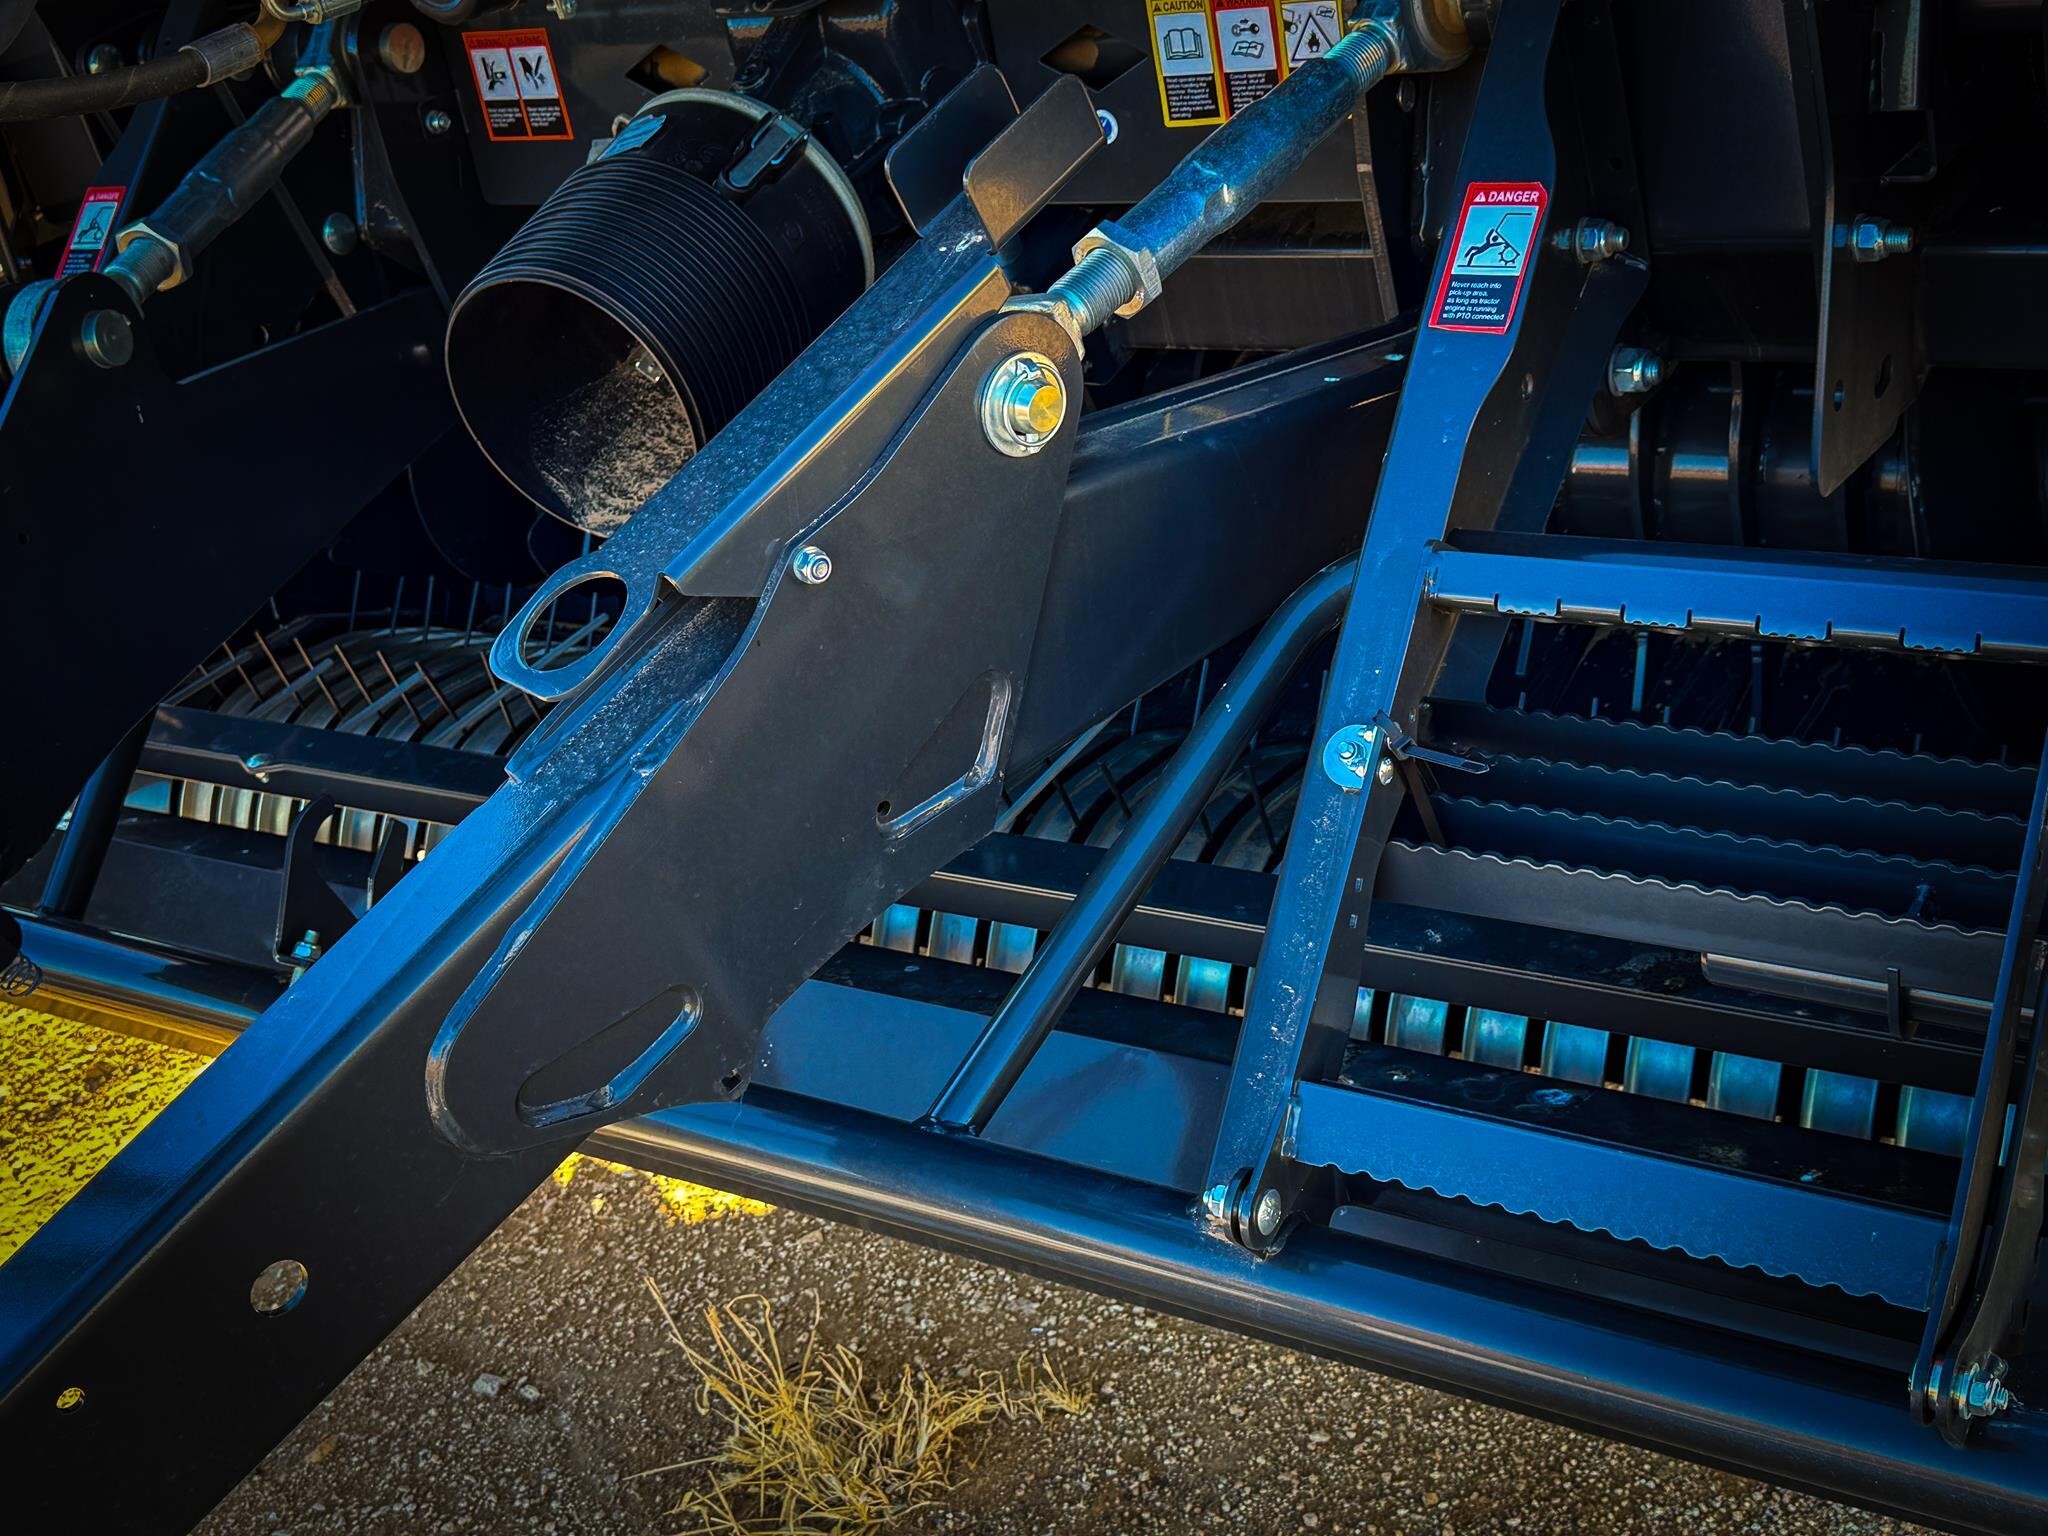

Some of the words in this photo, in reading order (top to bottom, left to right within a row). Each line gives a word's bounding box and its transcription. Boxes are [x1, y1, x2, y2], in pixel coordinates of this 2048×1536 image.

[1163, 0, 1203, 12] CAUTION
[1487, 191, 1540, 203] DANGER
[1448, 289, 1472, 297] pick-up
[1455, 297, 1470, 305] long
[1473, 305, 1497, 313] running
